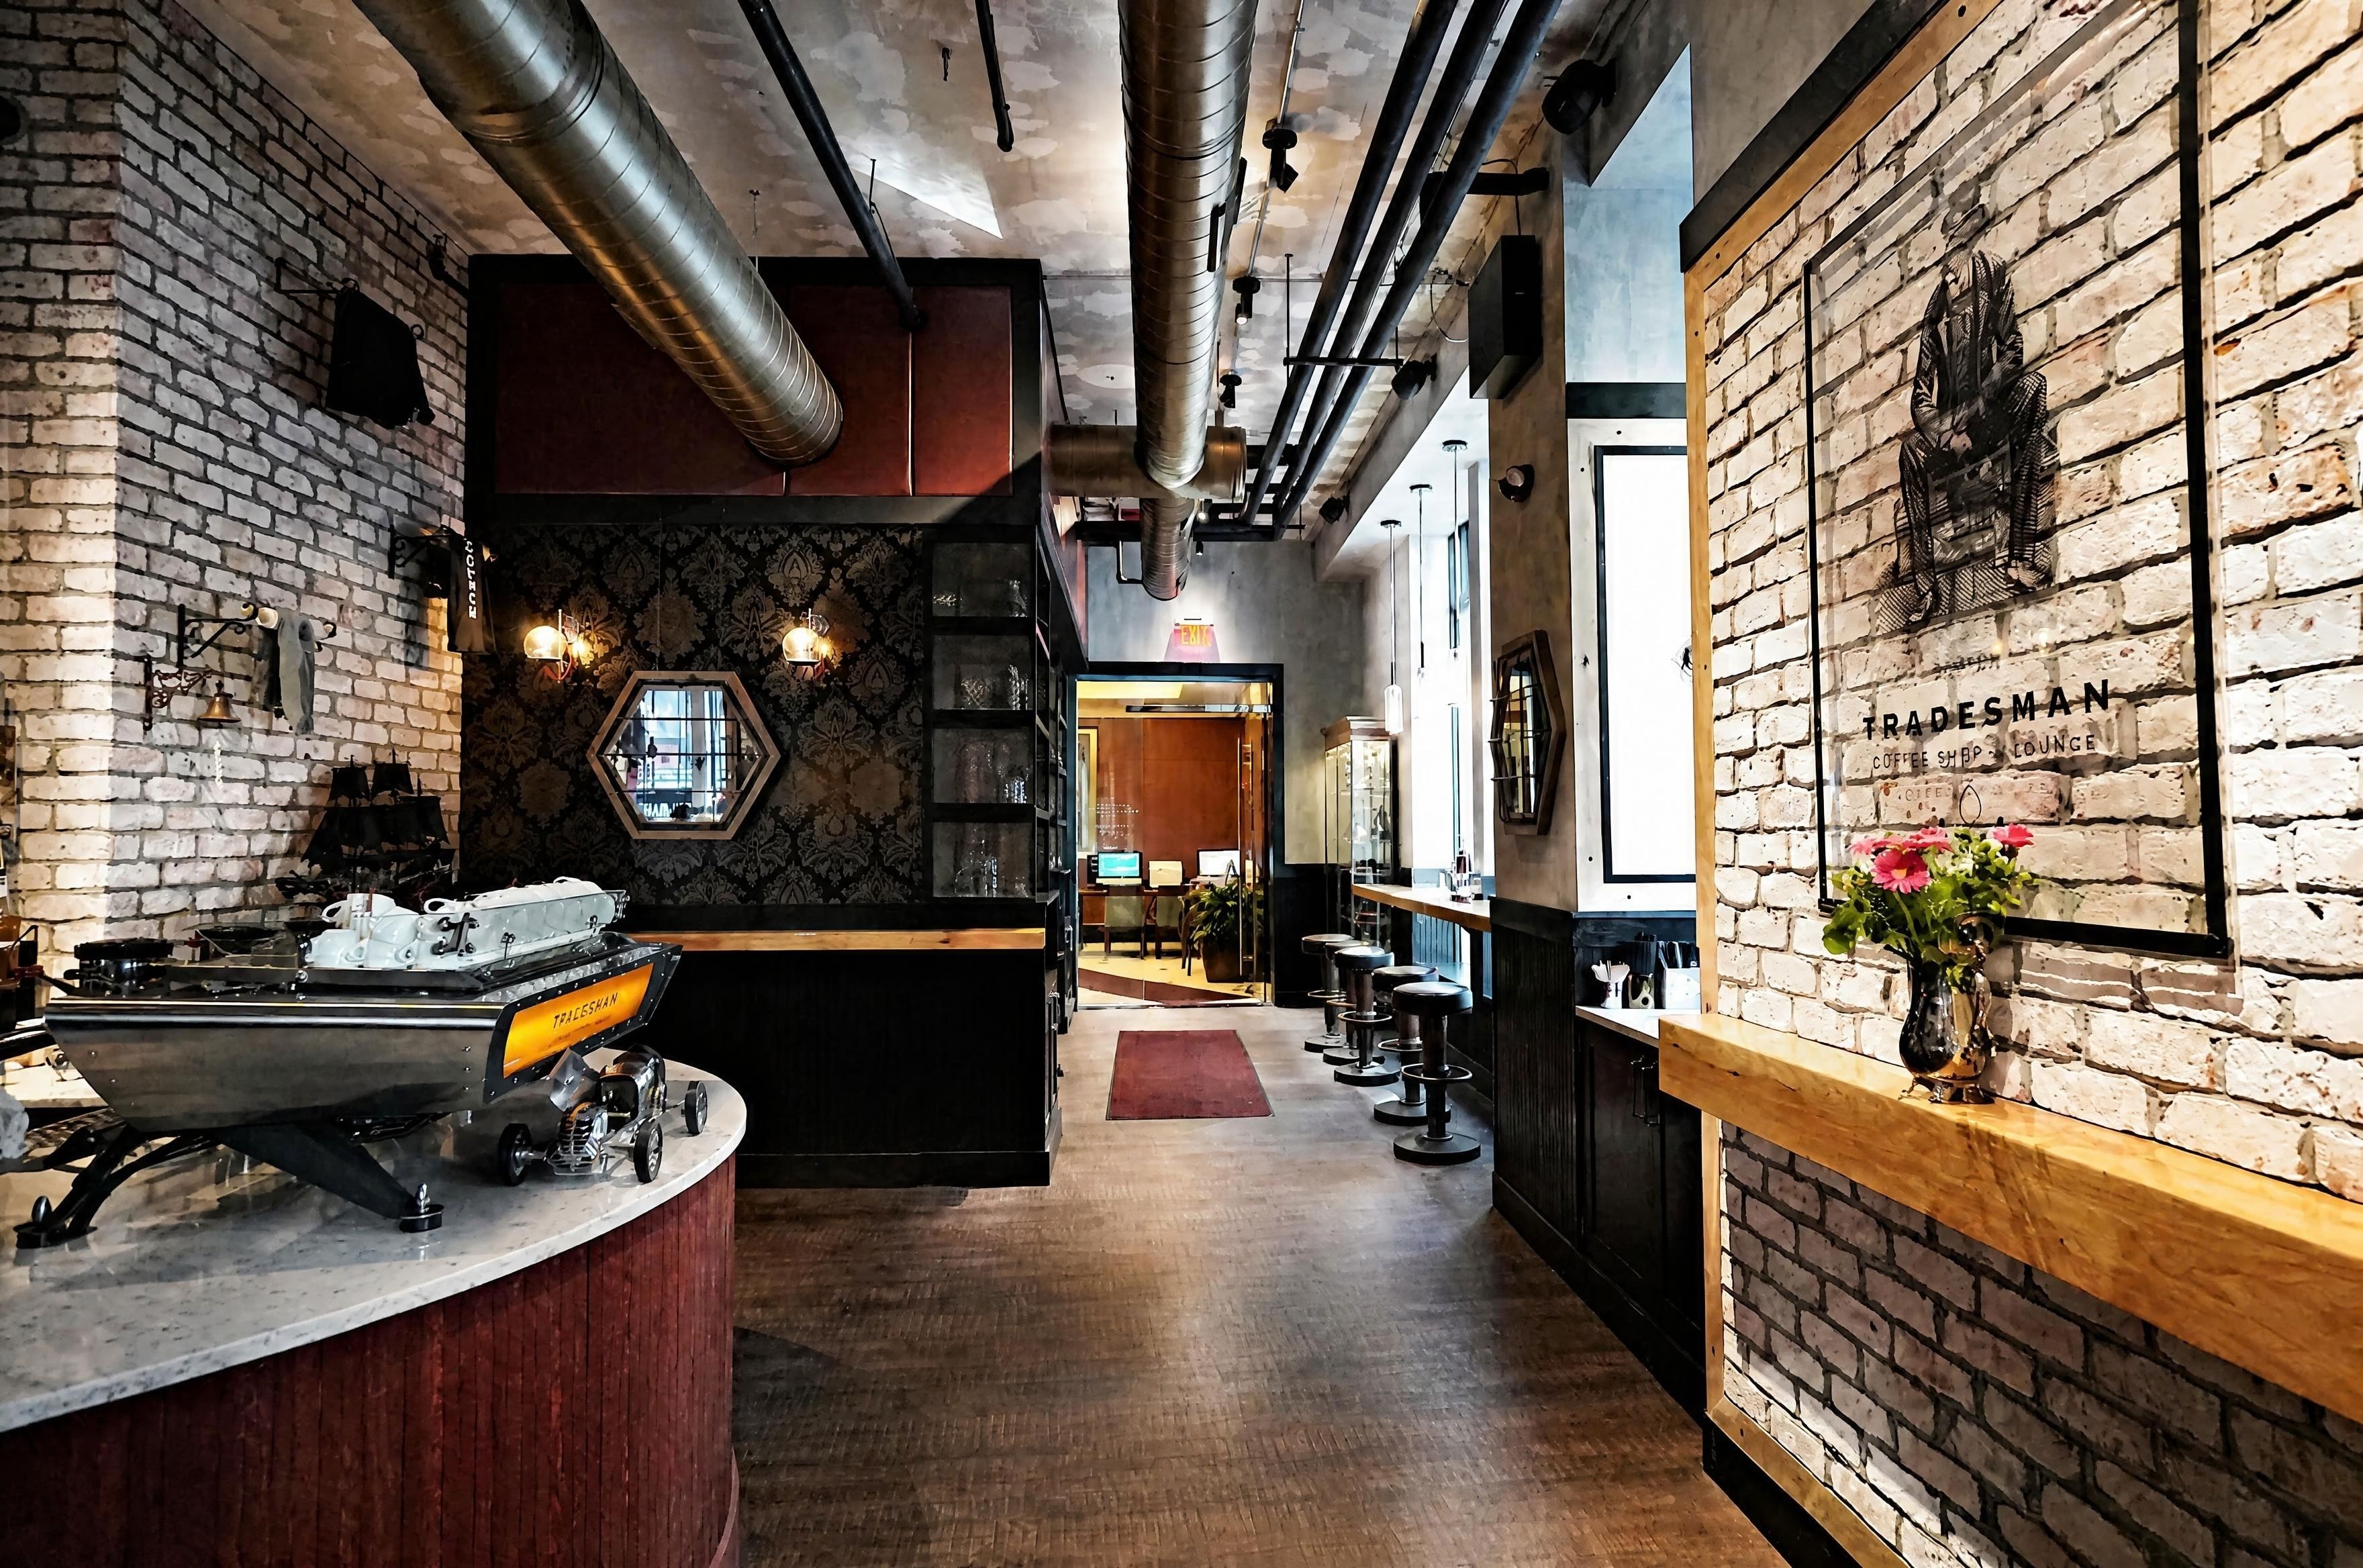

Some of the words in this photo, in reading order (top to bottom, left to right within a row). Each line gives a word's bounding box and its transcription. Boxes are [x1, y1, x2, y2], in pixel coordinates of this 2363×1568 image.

[1182, 625, 1212, 646] EXIT
[1863, 679, 2109, 740] TRADESMAN
[1874, 751, 1929, 769] COFFEE
[1937, 745, 1982, 768] SHOP
[2014, 734, 2095, 758] LOUNGE
